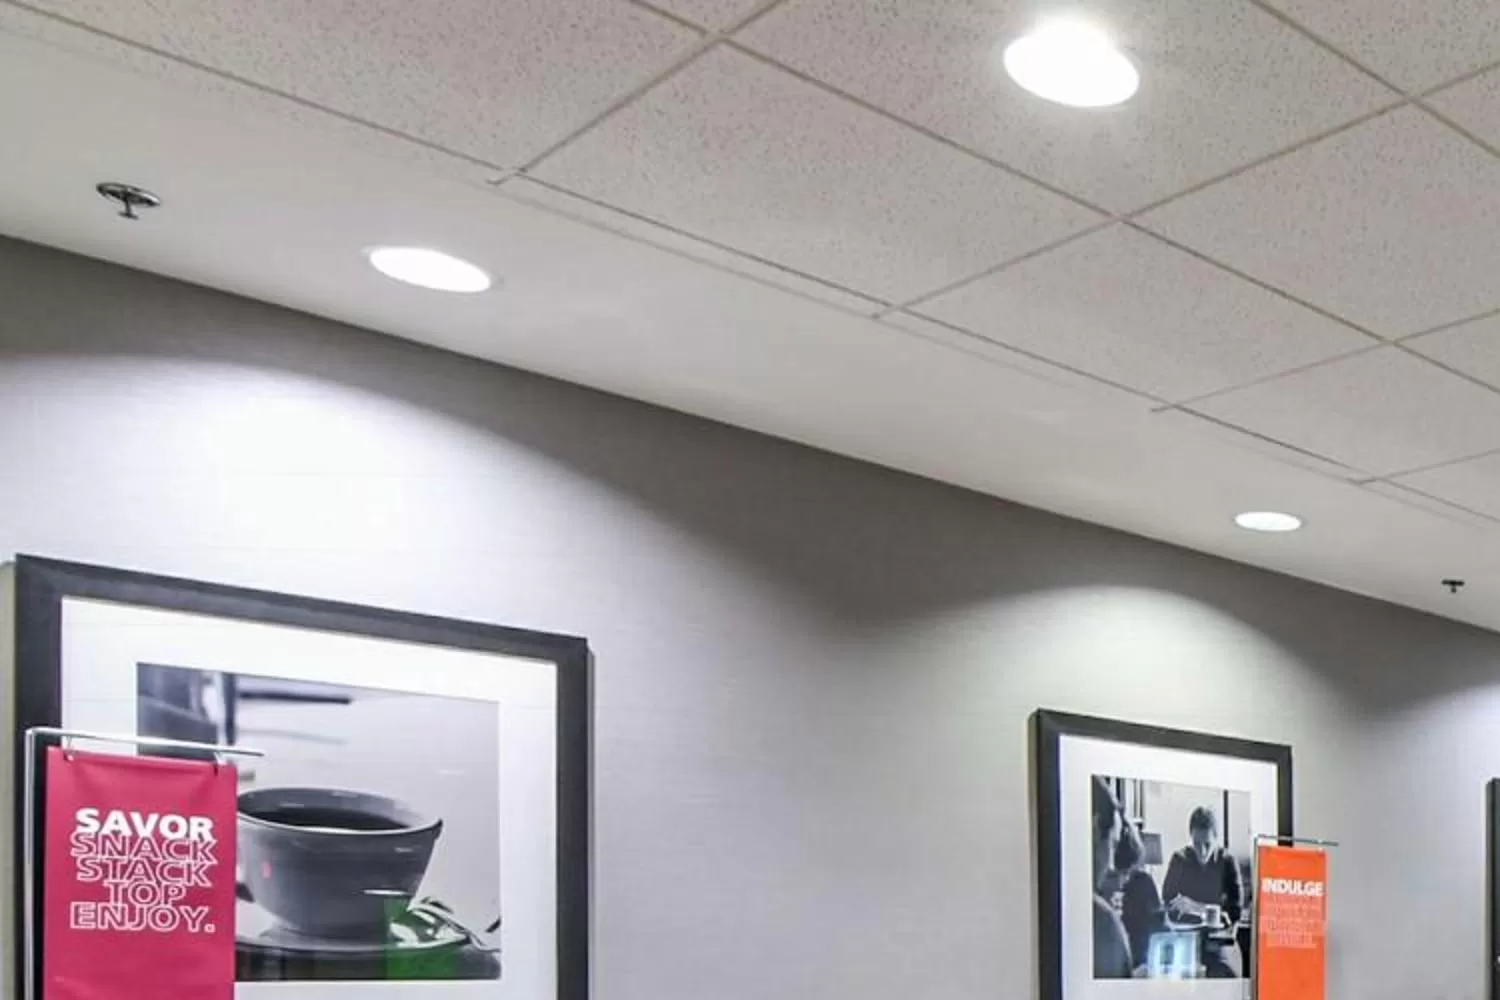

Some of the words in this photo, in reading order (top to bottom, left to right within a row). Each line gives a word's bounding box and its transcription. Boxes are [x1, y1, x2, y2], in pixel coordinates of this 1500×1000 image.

[75, 808, 214, 841] SAVOR
[70, 832, 218, 864] SNACK
[76, 856, 212, 887] STACK
[1261, 877, 1323, 896] INDULGE
[103, 880, 186, 906] TOP
[70, 901, 216, 933] ENJOY.
